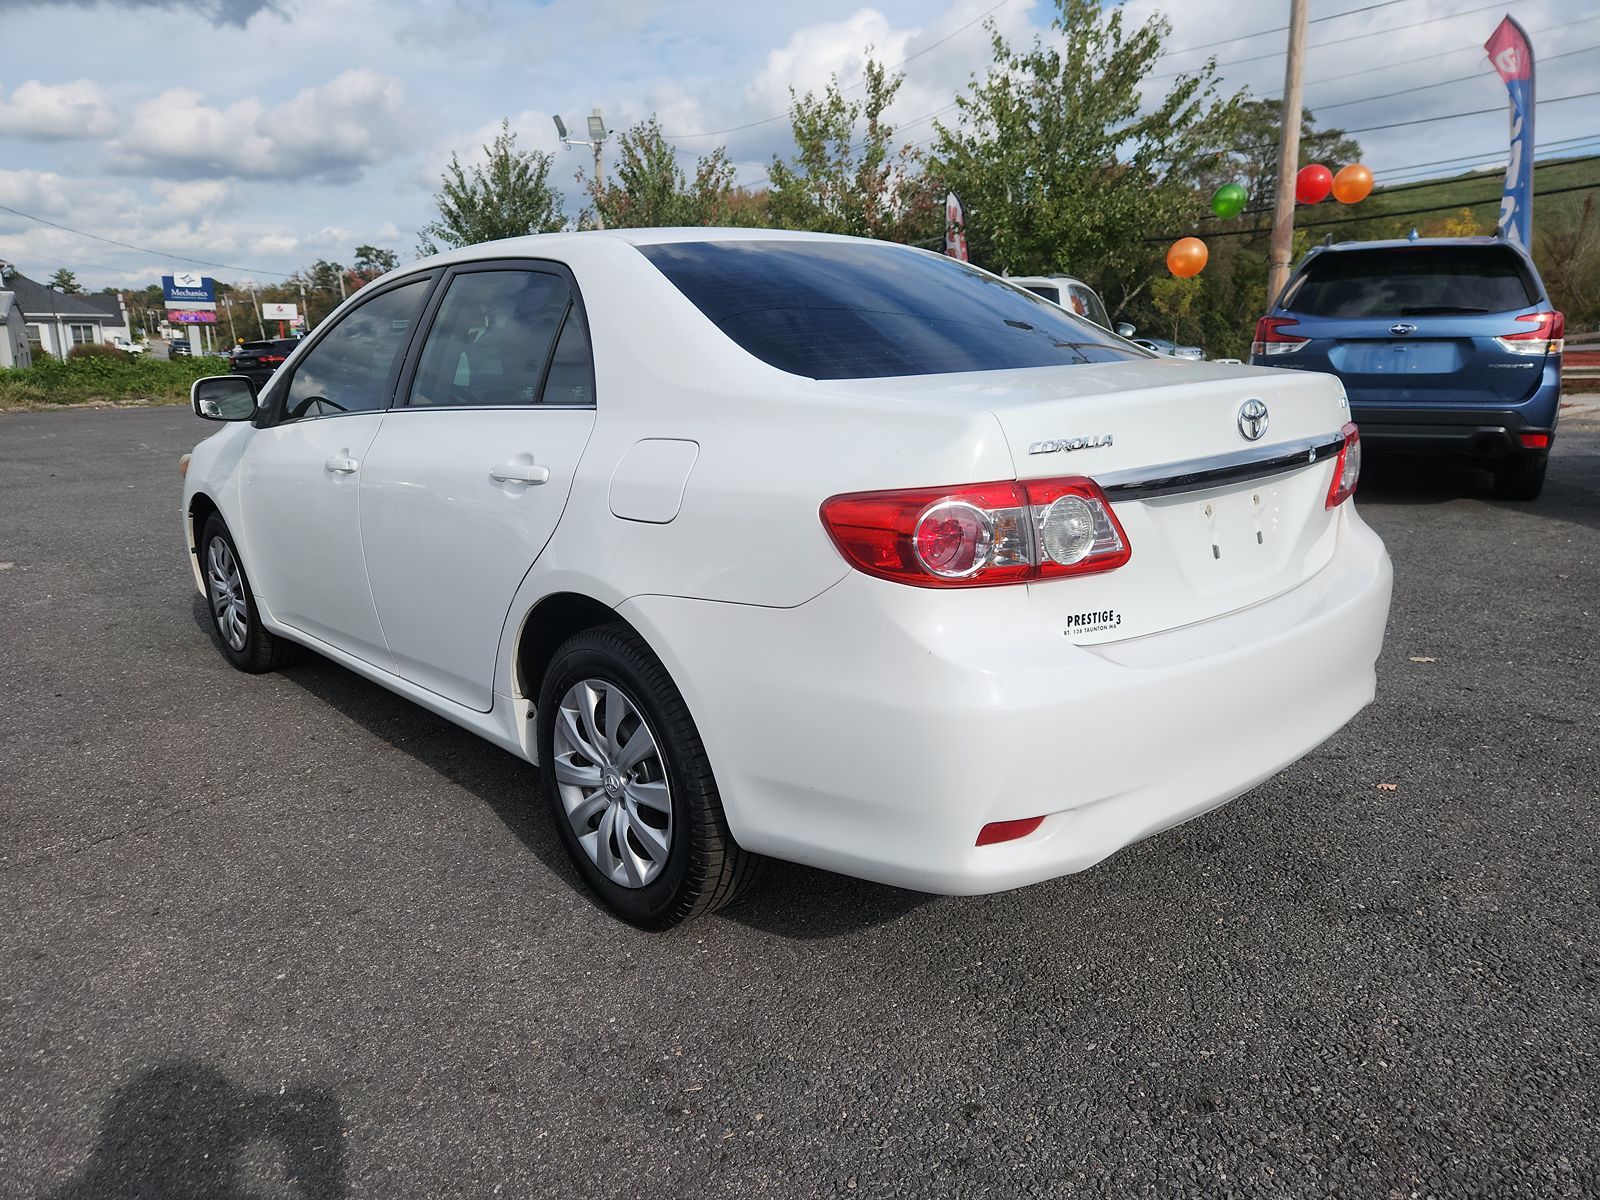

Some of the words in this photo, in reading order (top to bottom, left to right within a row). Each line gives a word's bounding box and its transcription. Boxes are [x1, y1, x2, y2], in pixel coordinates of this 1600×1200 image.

[171, 288, 208, 296] Mechanics
[1028, 434, 1113, 455] COROLLA
[1067, 610, 1114, 627] PRESTIGE
[1116, 614, 1121, 624] 3
